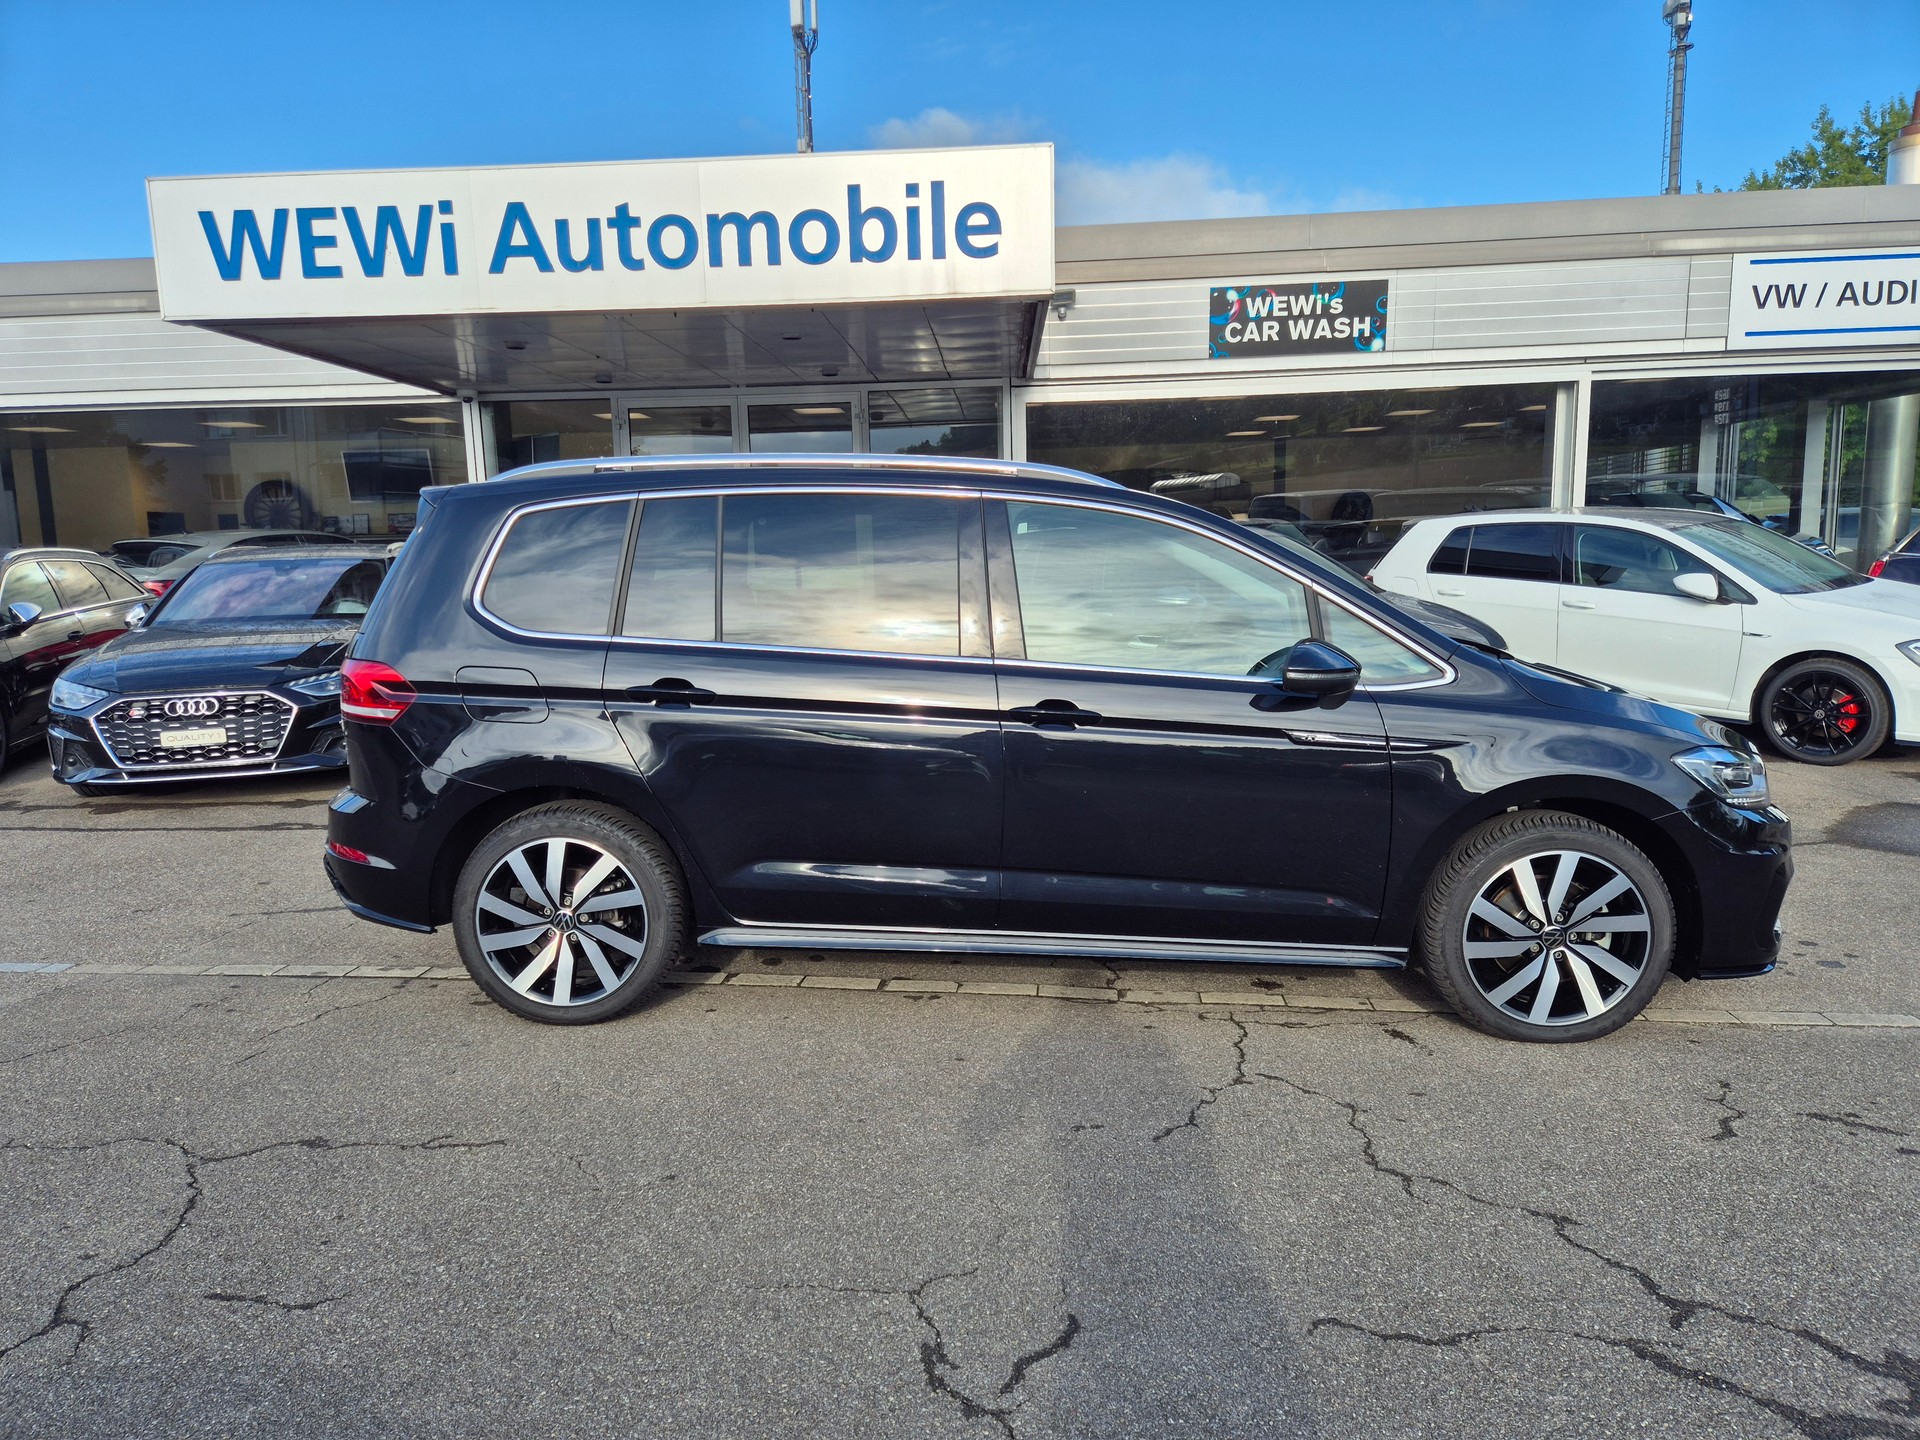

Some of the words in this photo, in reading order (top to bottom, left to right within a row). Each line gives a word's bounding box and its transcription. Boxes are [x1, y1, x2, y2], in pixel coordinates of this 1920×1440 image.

[198, 200, 458, 281] WEWi
[488, 180, 1002, 274] Automobile
[1245, 293, 1344, 318] WEWi's
[1752, 283, 1808, 309] VW
[1815, 282, 1828, 308] /
[1836, 279, 1918, 307] AUDI
[1225, 321, 1280, 344] CAR
[1288, 316, 1371, 341] WASH
[166, 732, 214, 743] QUALITY
